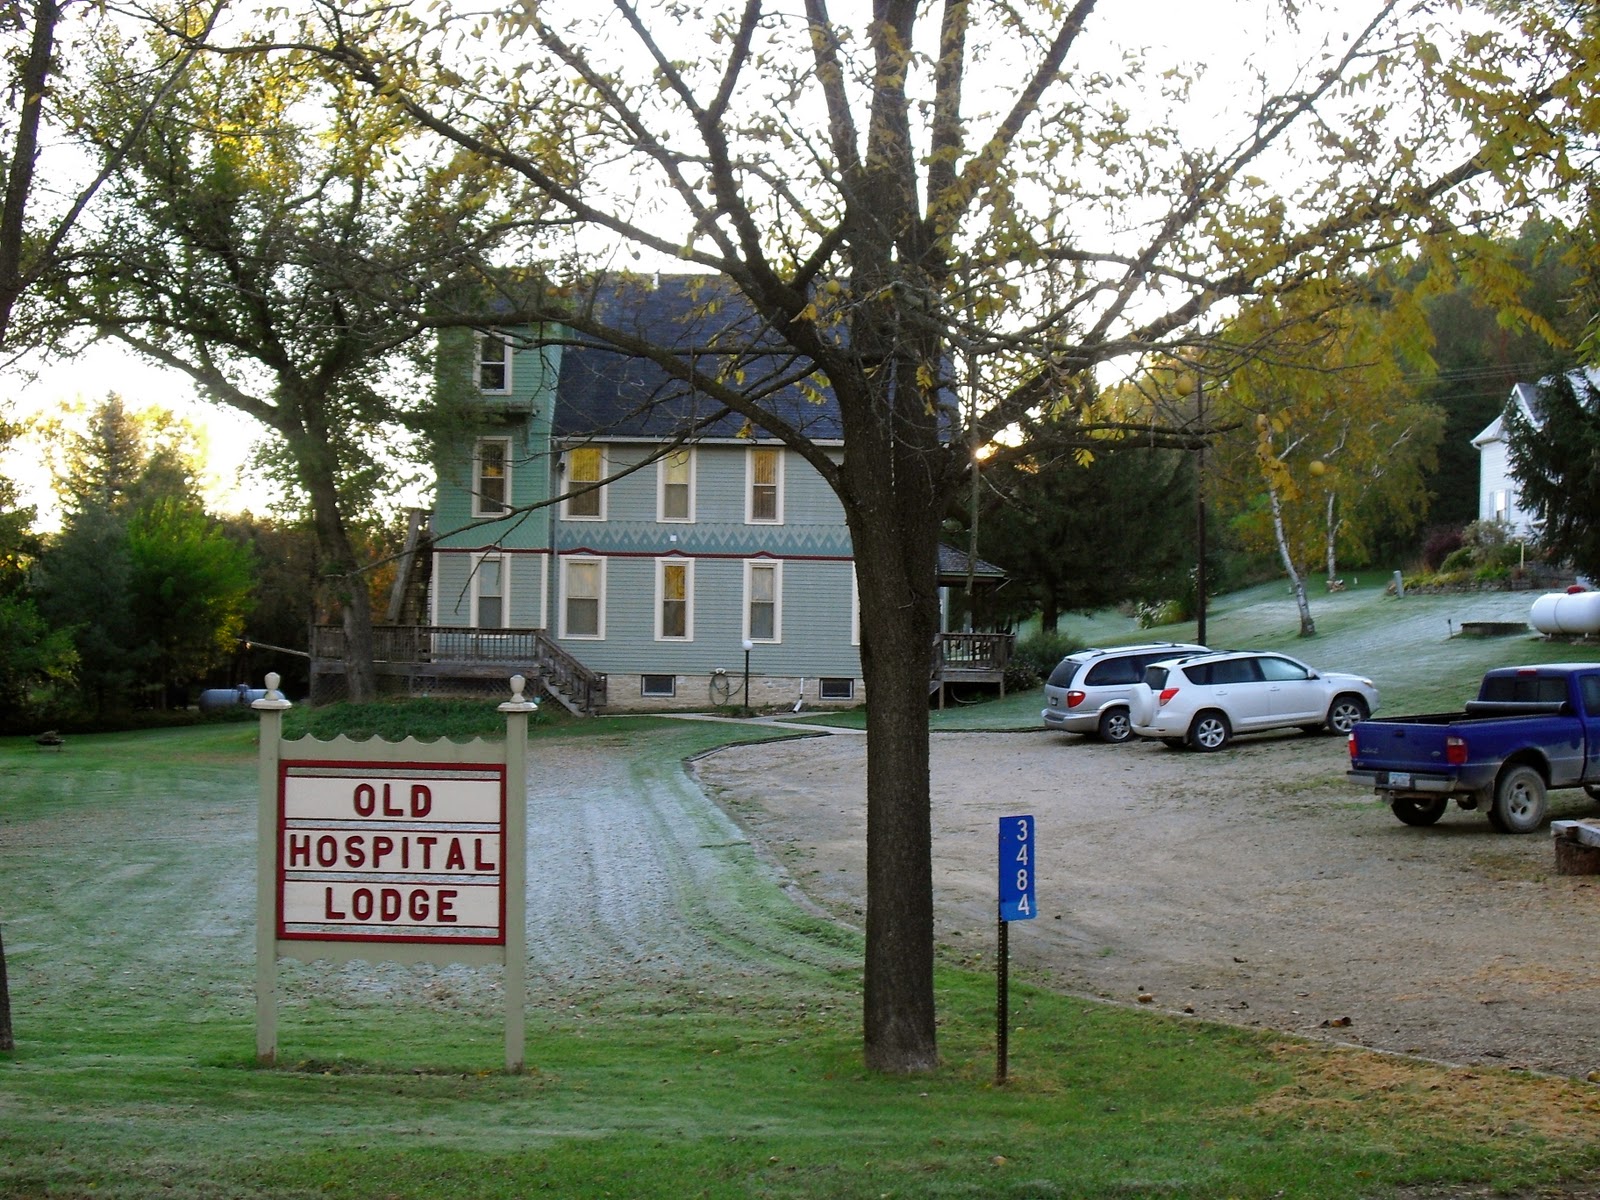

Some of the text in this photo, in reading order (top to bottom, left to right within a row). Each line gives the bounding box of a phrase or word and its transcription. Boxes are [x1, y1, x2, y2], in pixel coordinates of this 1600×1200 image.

[353, 783, 432, 818] OLD
[290, 834, 495, 871] HOSPITAL
[1016, 819, 1030, 916] 3484
[325, 887, 457, 922] LODGE
